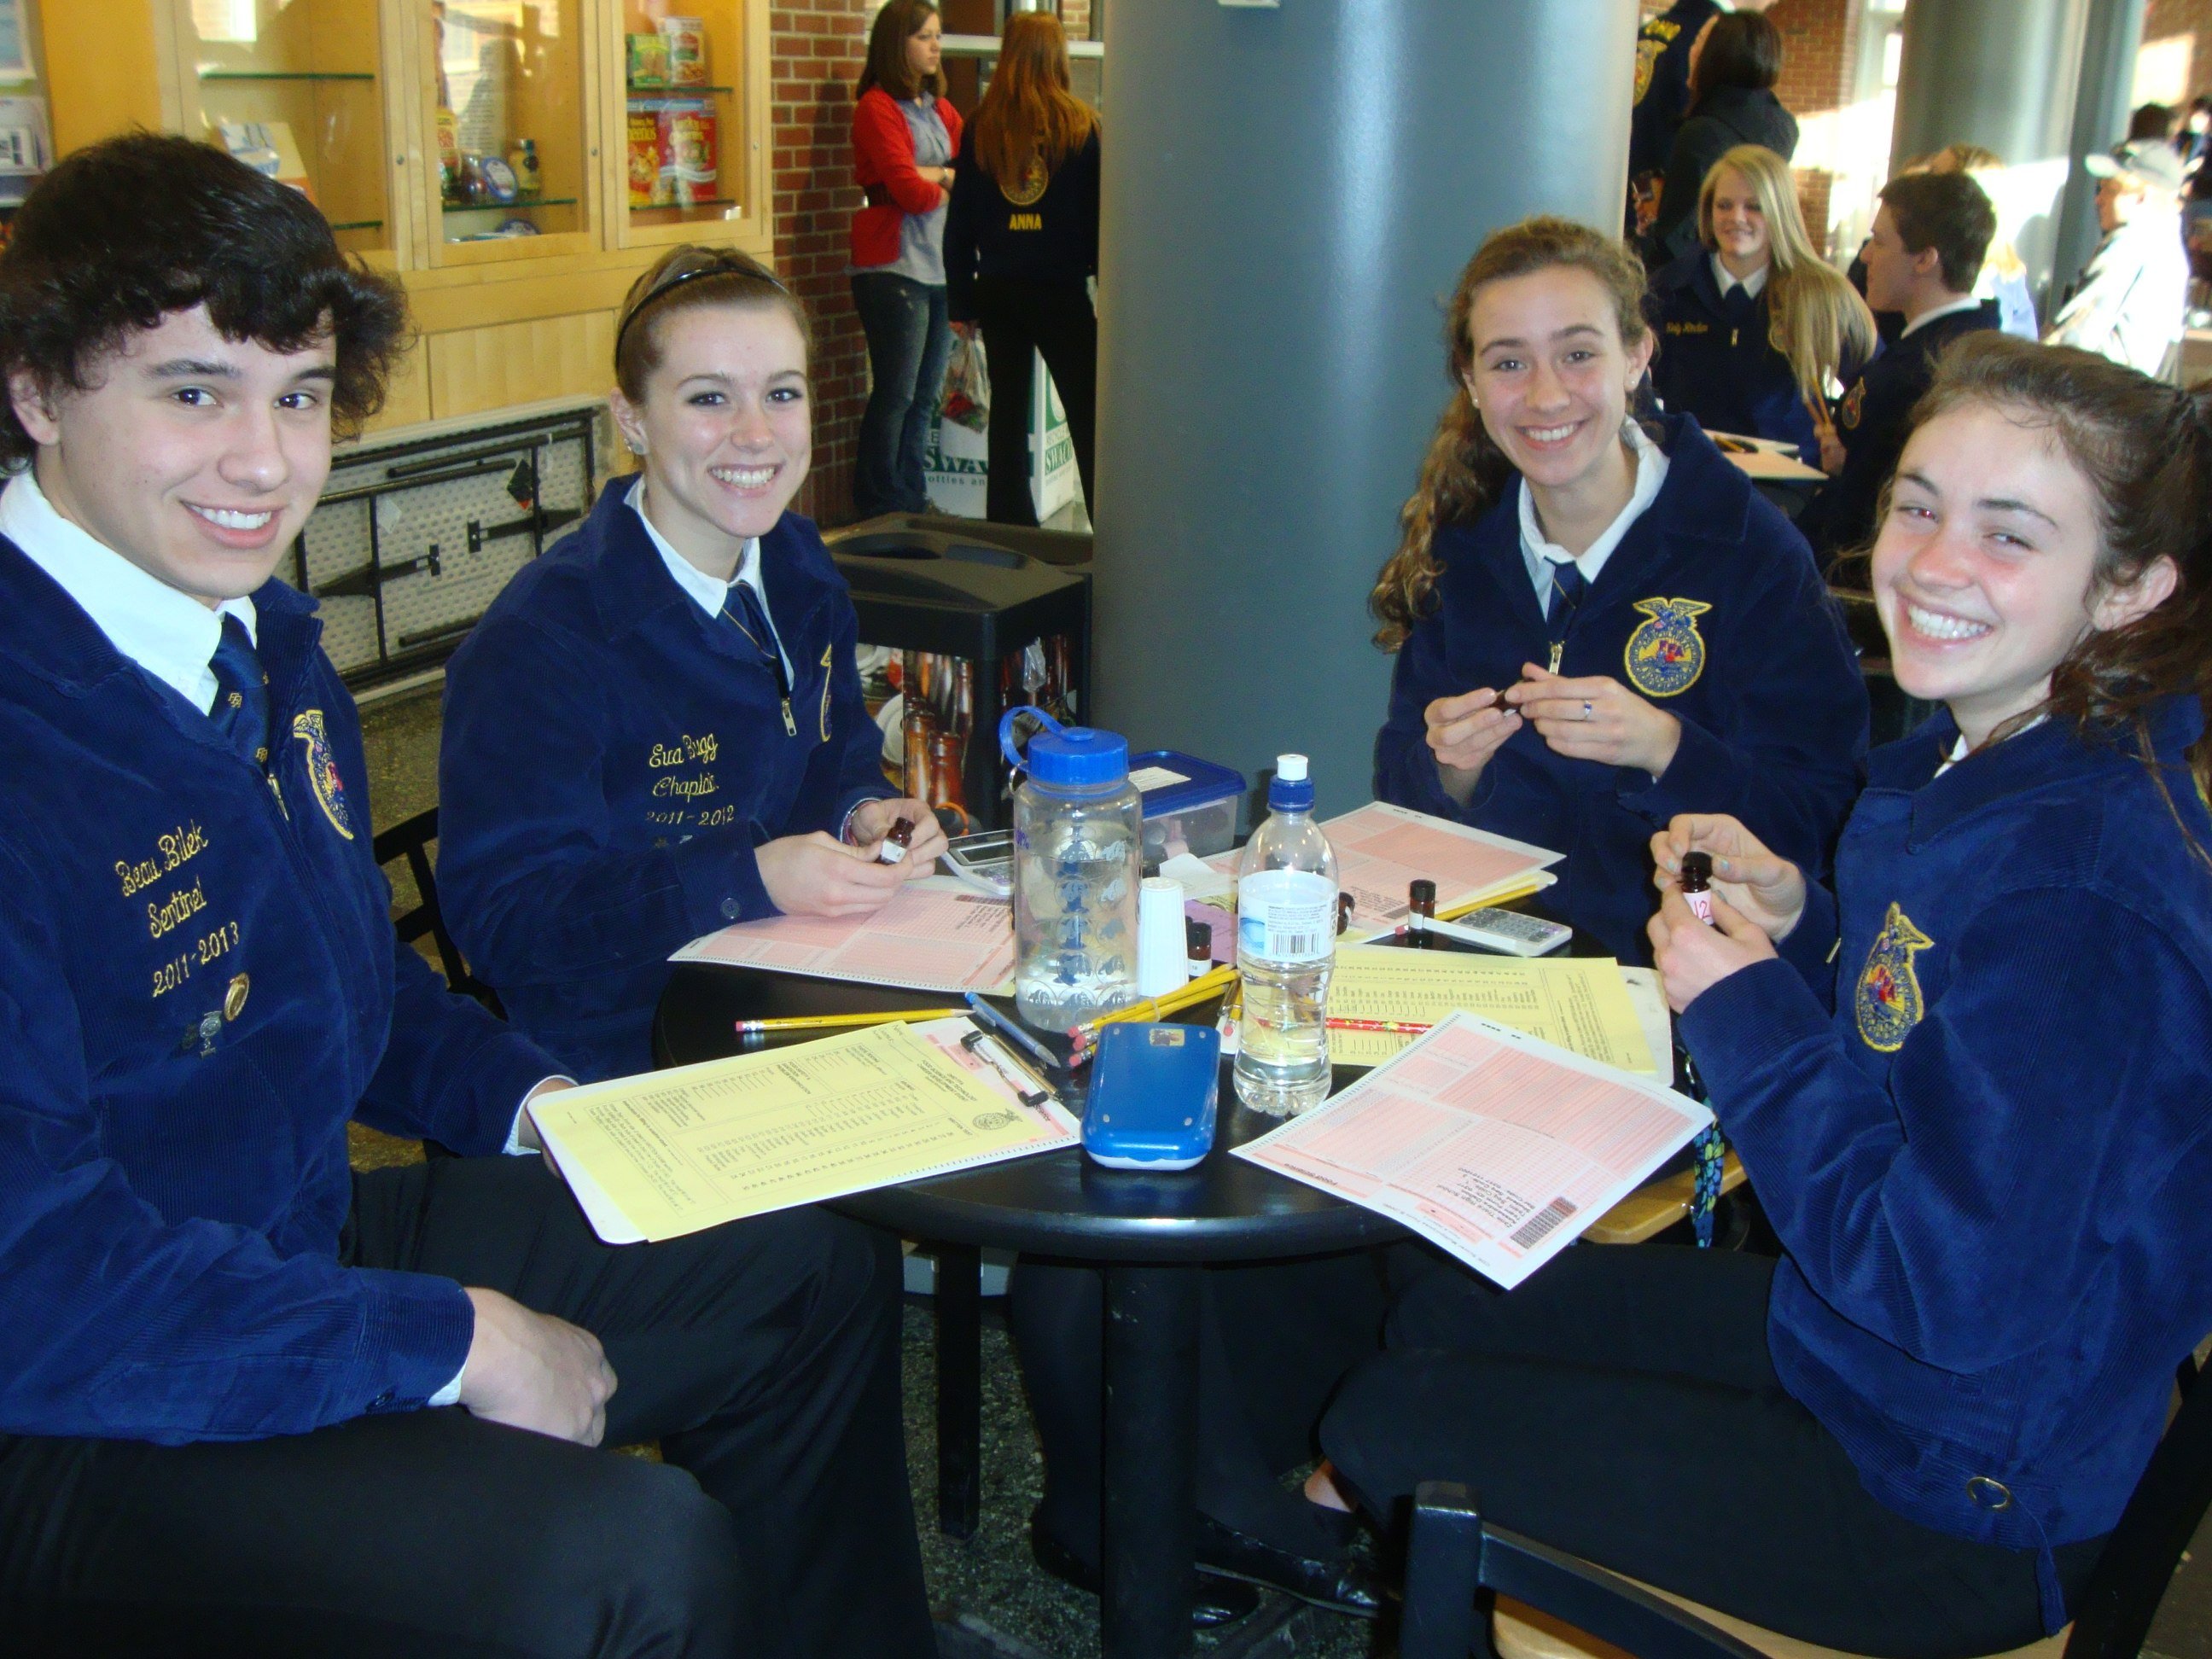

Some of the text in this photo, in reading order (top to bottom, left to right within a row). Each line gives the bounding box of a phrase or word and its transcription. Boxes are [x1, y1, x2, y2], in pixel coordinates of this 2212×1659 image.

[1010, 213, 1041, 230] ANNA
[115, 818, 209, 897] Beau Bilek
[148, 874, 207, 940] Sentinel
